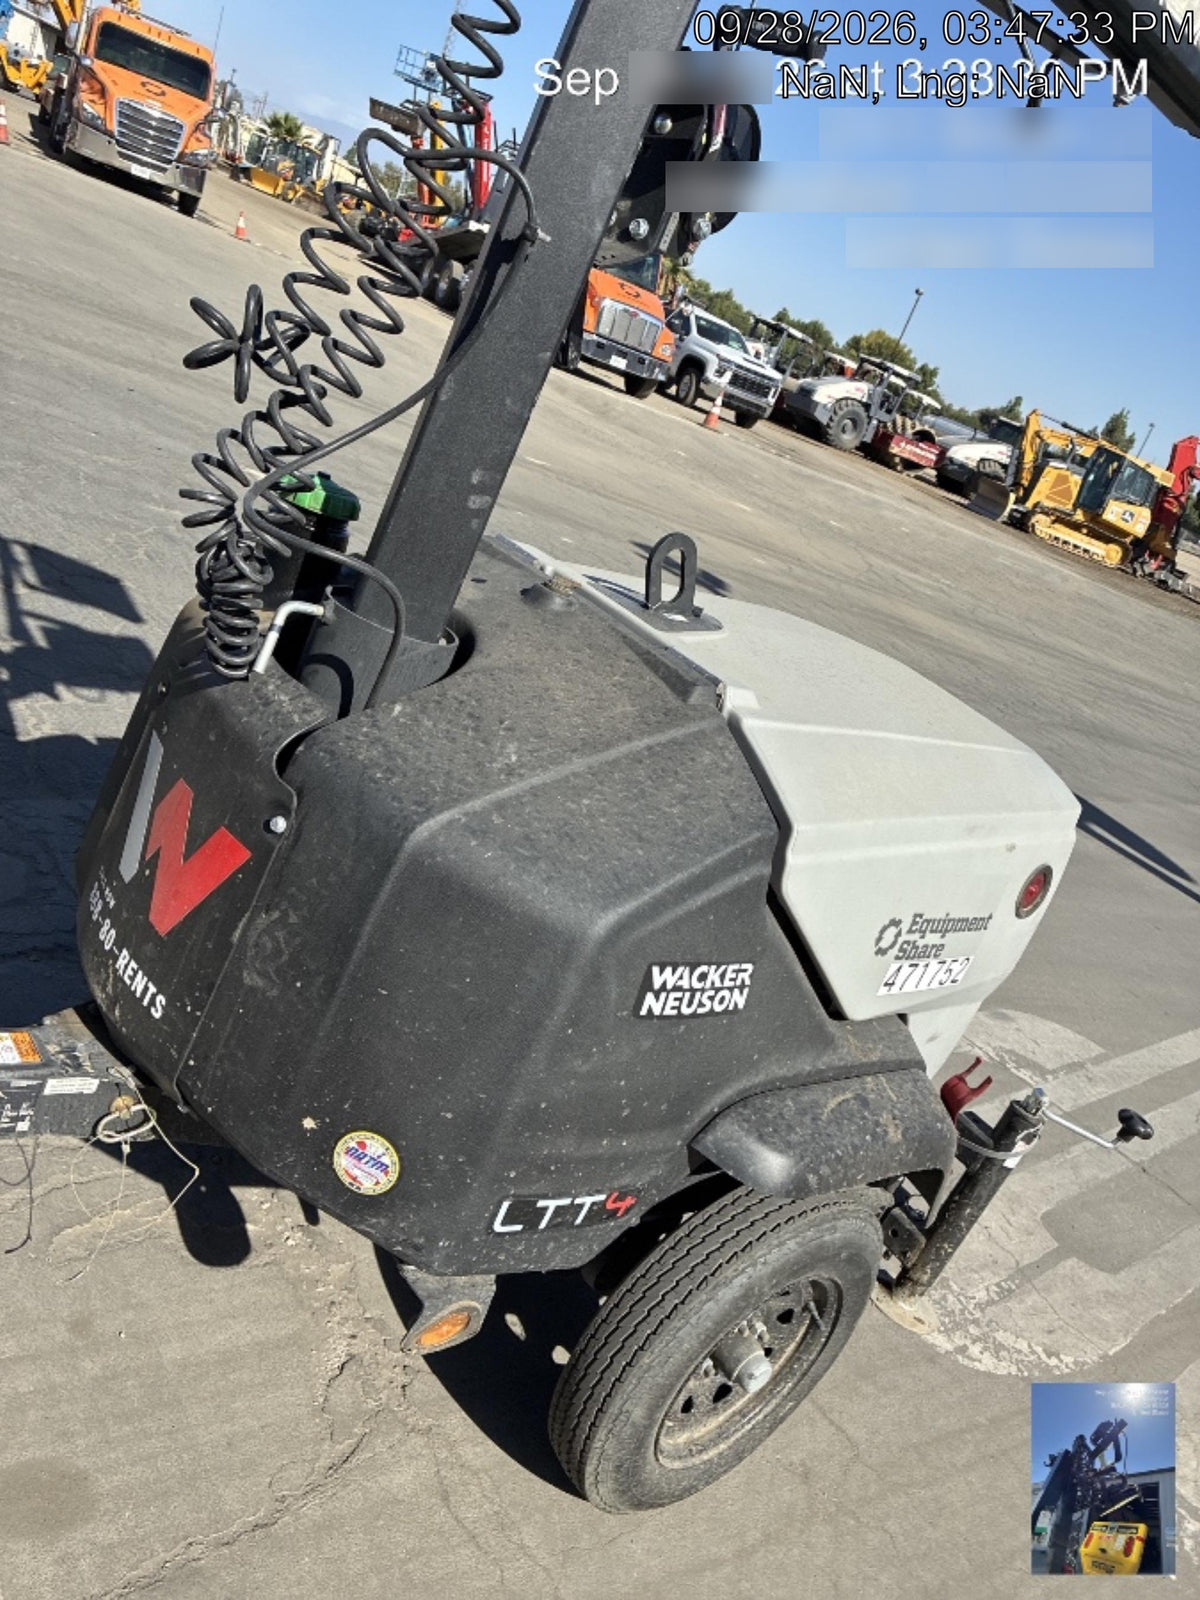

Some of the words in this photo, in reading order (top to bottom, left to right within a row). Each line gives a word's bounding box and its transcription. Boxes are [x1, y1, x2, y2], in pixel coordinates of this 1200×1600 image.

[906, 912, 993, 939] Equipment
[894, 940, 945, 960] Share
[651, 963, 755, 990] WACKER
[882, 957, 971, 992] 471752
[640, 986, 750, 1016] NEUSON
